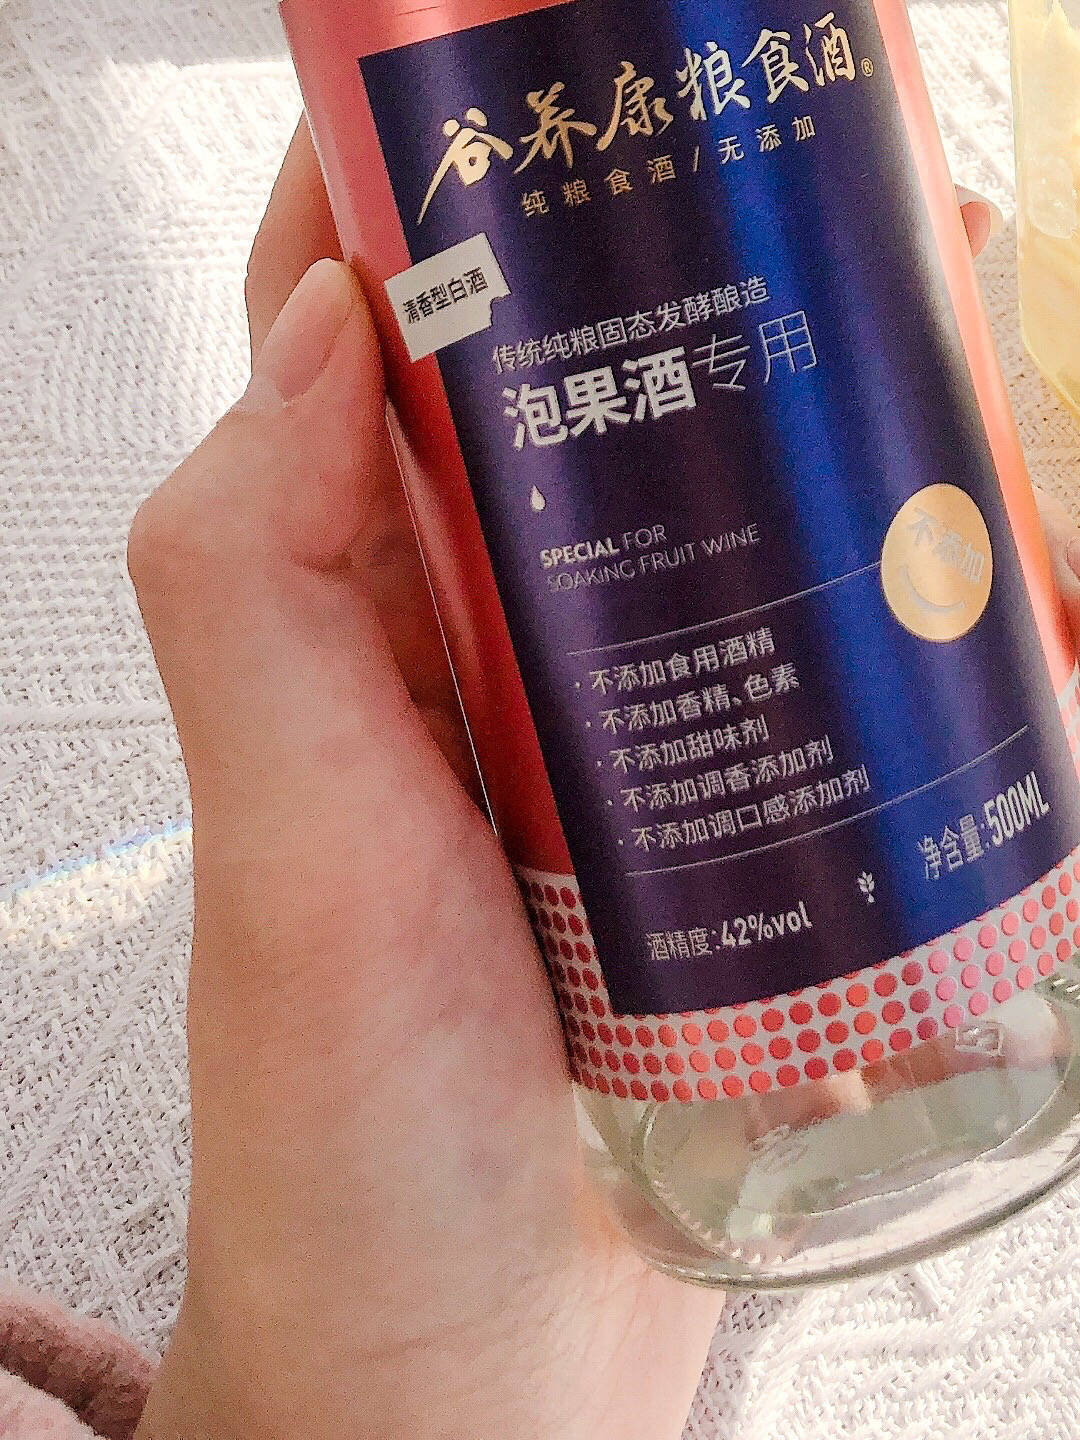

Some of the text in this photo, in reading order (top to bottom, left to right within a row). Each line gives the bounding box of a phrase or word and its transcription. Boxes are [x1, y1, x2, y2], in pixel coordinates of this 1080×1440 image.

[416, 10, 856, 225] 谷养康粮食酒
[402, 266, 488, 325] 清香型白酒
[492, 275, 771, 375] 传统纯粮固态发酵酿造
[502, 310, 817, 451] 泡果酒专用
[539, 524, 668, 570] SPECIAL FOR
[639, 542, 696, 574] FRUIT
[701, 523, 761, 555] WINE
[590, 626, 775, 694] 不添加食用酒精
[608, 714, 770, 773] 不添加甜味剂
[620, 734, 834, 812] 不添加调香添加剂
[631, 764, 871, 852] 不添加调口感添加剂
